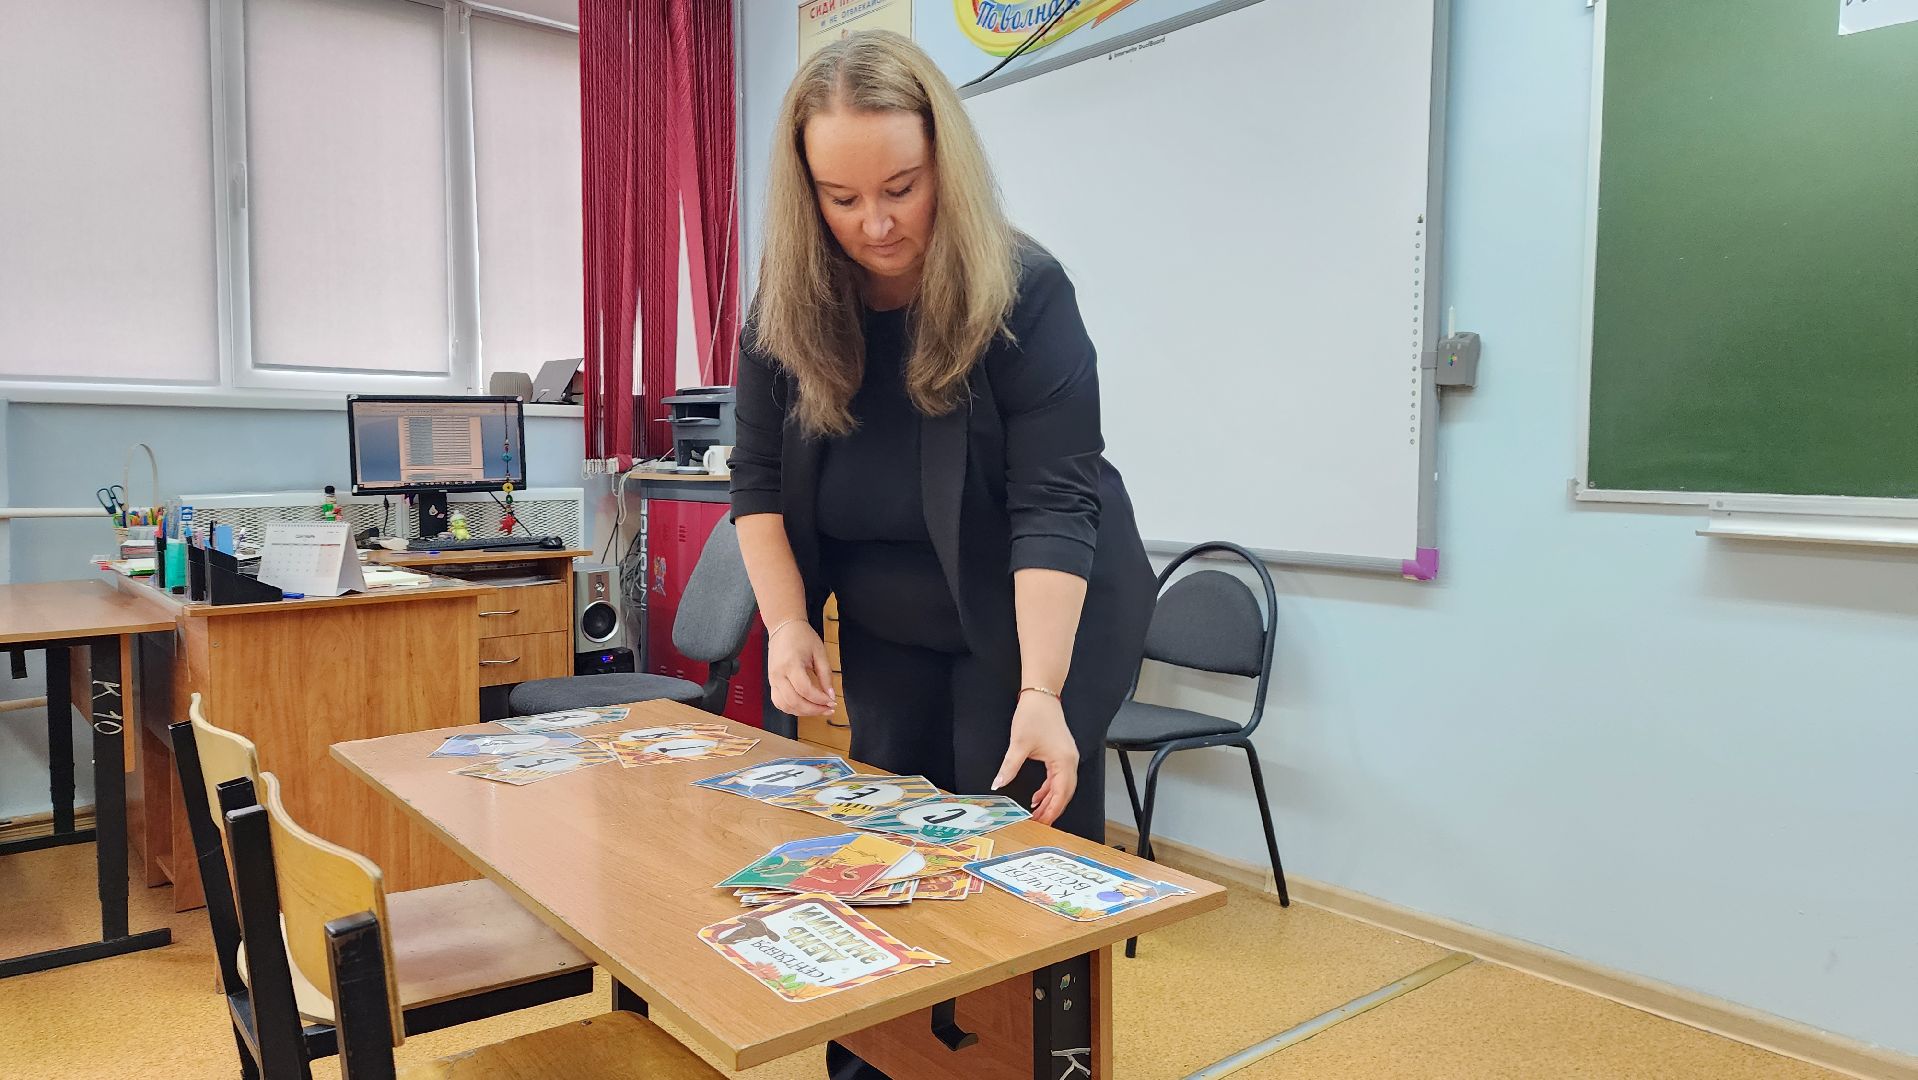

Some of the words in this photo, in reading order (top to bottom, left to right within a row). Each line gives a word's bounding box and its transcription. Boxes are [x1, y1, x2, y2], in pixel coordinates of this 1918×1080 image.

[976, 1, 997, 29] По
[1001, 0, 1080, 31] волна
[93, 710, 123, 735] 10
[783, 925, 848, 964] ДЕНЬ
[788, 905, 889, 965] ЗНАНИЙ
[750, 938, 825, 979] СЕНТЯБРЯ
